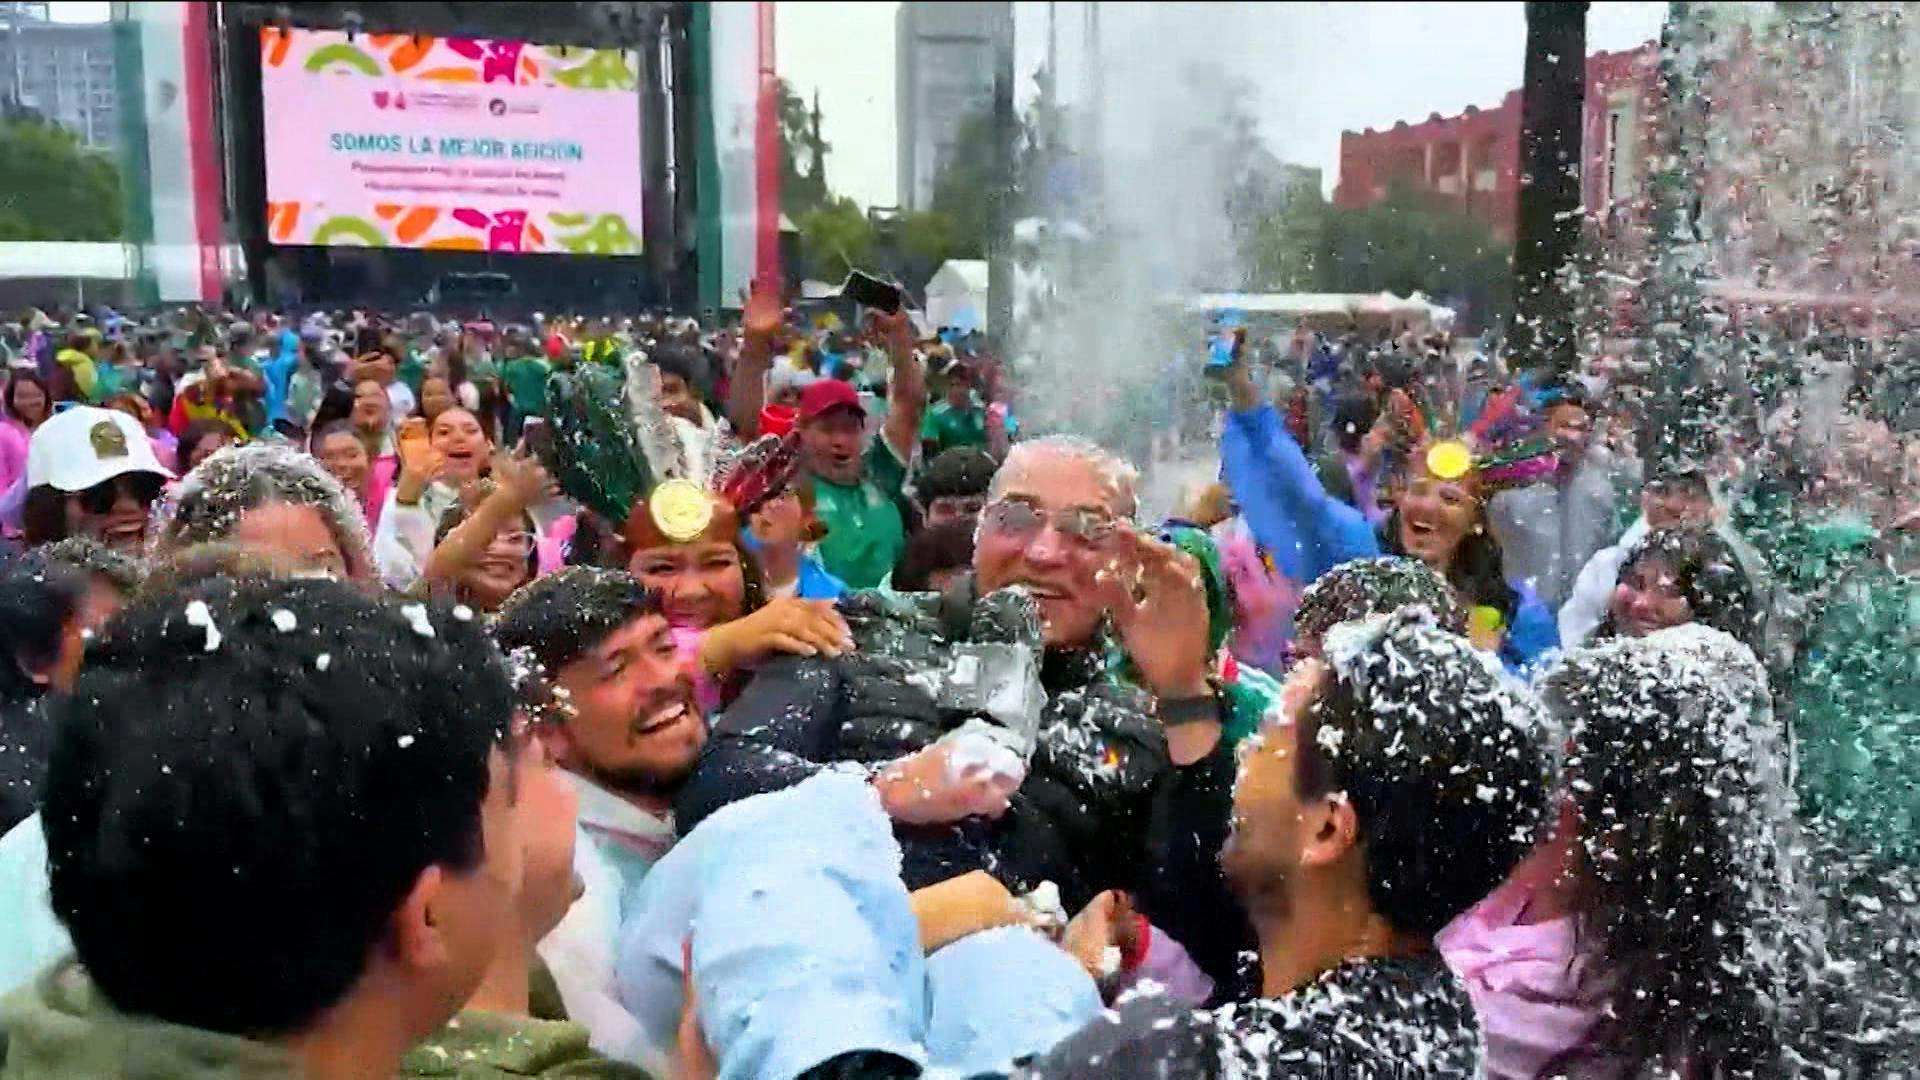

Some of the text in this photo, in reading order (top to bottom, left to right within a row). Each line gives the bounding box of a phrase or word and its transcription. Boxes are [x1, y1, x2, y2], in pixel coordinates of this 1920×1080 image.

[330, 132, 401, 152] SOMOS
[408, 136, 433, 154] LA
[439, 137, 505, 157] MEJOR
